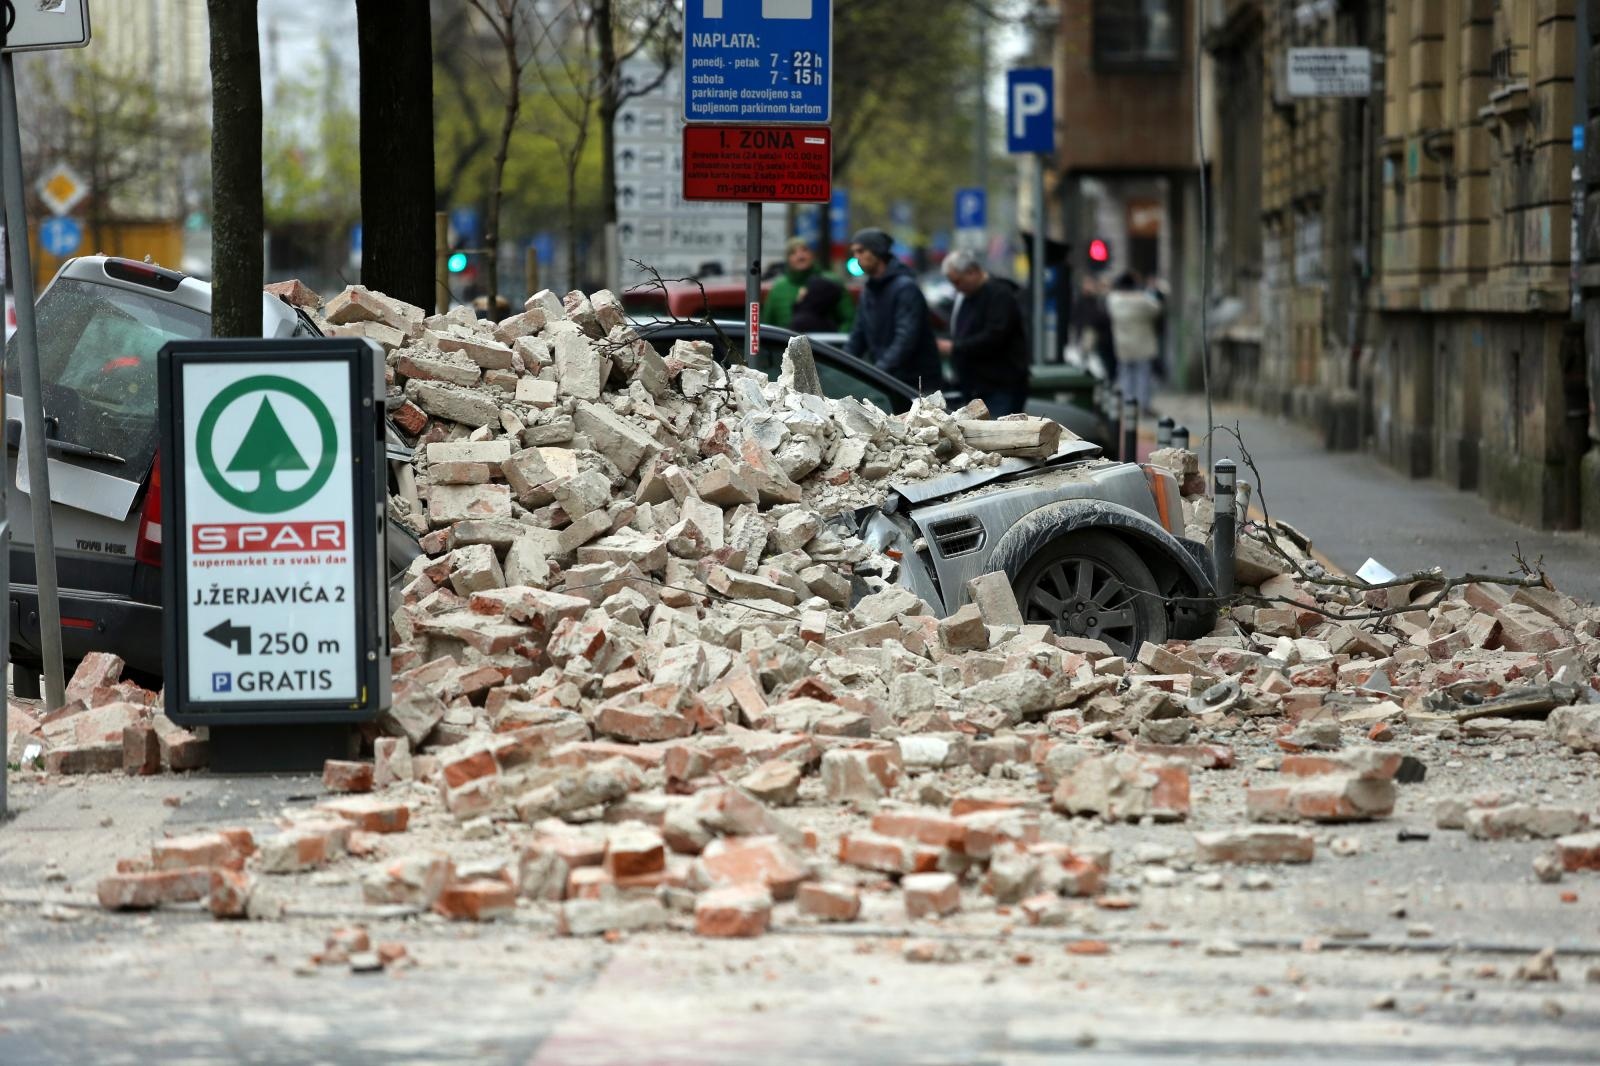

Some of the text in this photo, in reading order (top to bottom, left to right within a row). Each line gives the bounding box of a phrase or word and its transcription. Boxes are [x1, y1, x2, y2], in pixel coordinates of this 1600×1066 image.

[692, 33, 760, 48] NAPLATA:
[692, 57, 725, 69] ponedj.
[735, 57, 760, 68] petak
[770, 53, 779, 67] 7
[793, 51, 811, 67] 22
[814, 54, 822, 68] h
[692, 74, 724, 84] subota
[770, 71, 779, 85] 7
[794, 69, 811, 84] 15
[814, 72, 822, 85] h
[692, 88, 802, 100] parkiranje dozvoljeno sa
[692, 102, 821, 115] kupljenom parkirnom kartom
[1013, 83, 1047, 138] P
[739, 131, 795, 149] ZONA
[716, 183, 823, 196] m-parking 700101
[197, 524, 341, 551] SPAR
[192, 555, 347, 568] supermarket za svaki dan
[193, 582, 345, 606] J.ŽERJAVIĆA 2
[259, 633, 340, 655] 250 m
[215, 670, 332, 692] P GRATIS
